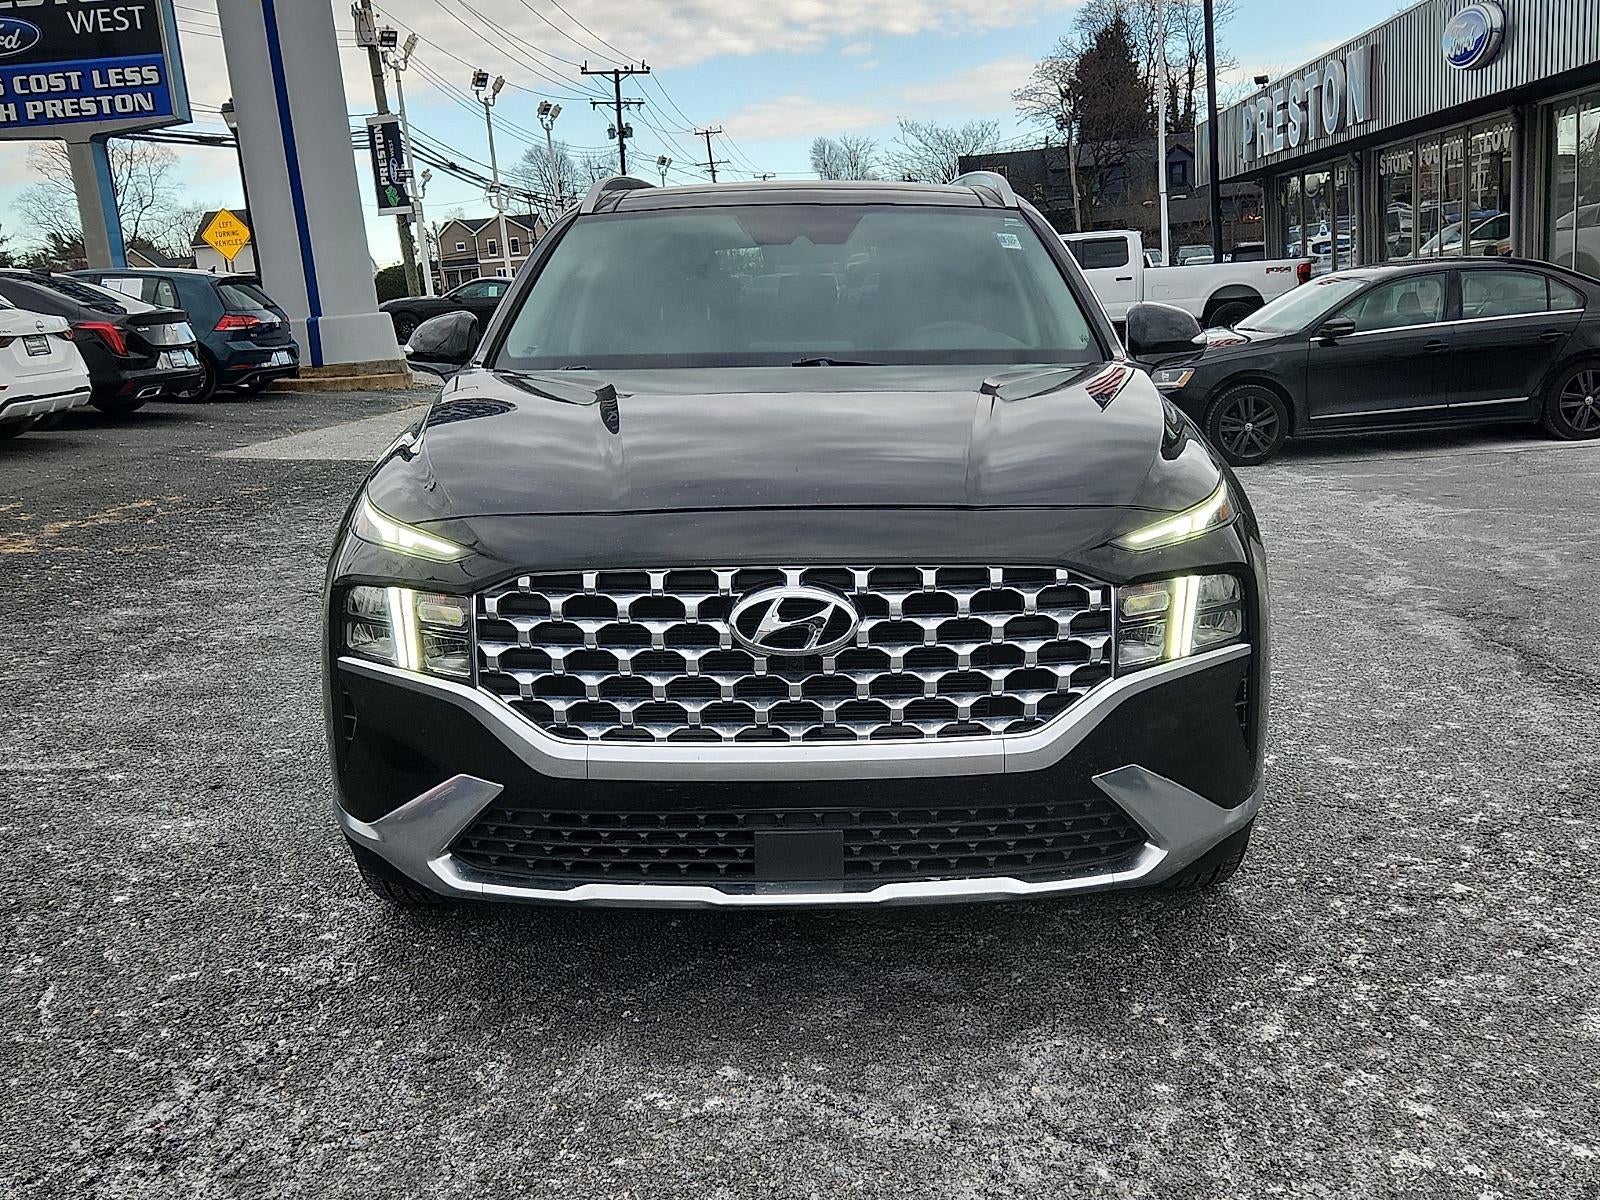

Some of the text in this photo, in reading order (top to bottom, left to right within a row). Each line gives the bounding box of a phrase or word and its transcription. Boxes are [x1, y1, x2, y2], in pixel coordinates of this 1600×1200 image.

[67, 6, 145, 34] WEST
[1450, 21, 1477, 58] Ford
[12, 71, 82, 94] COST
[92, 65, 160, 89] LESS
[25, 92, 154, 120] PRESTON
[1242, 45, 1368, 162] PRESTON
[373, 124, 390, 186] PRESTON
[214, 230, 239, 238] TURNING
[214, 238, 243, 247] VEHICLES
